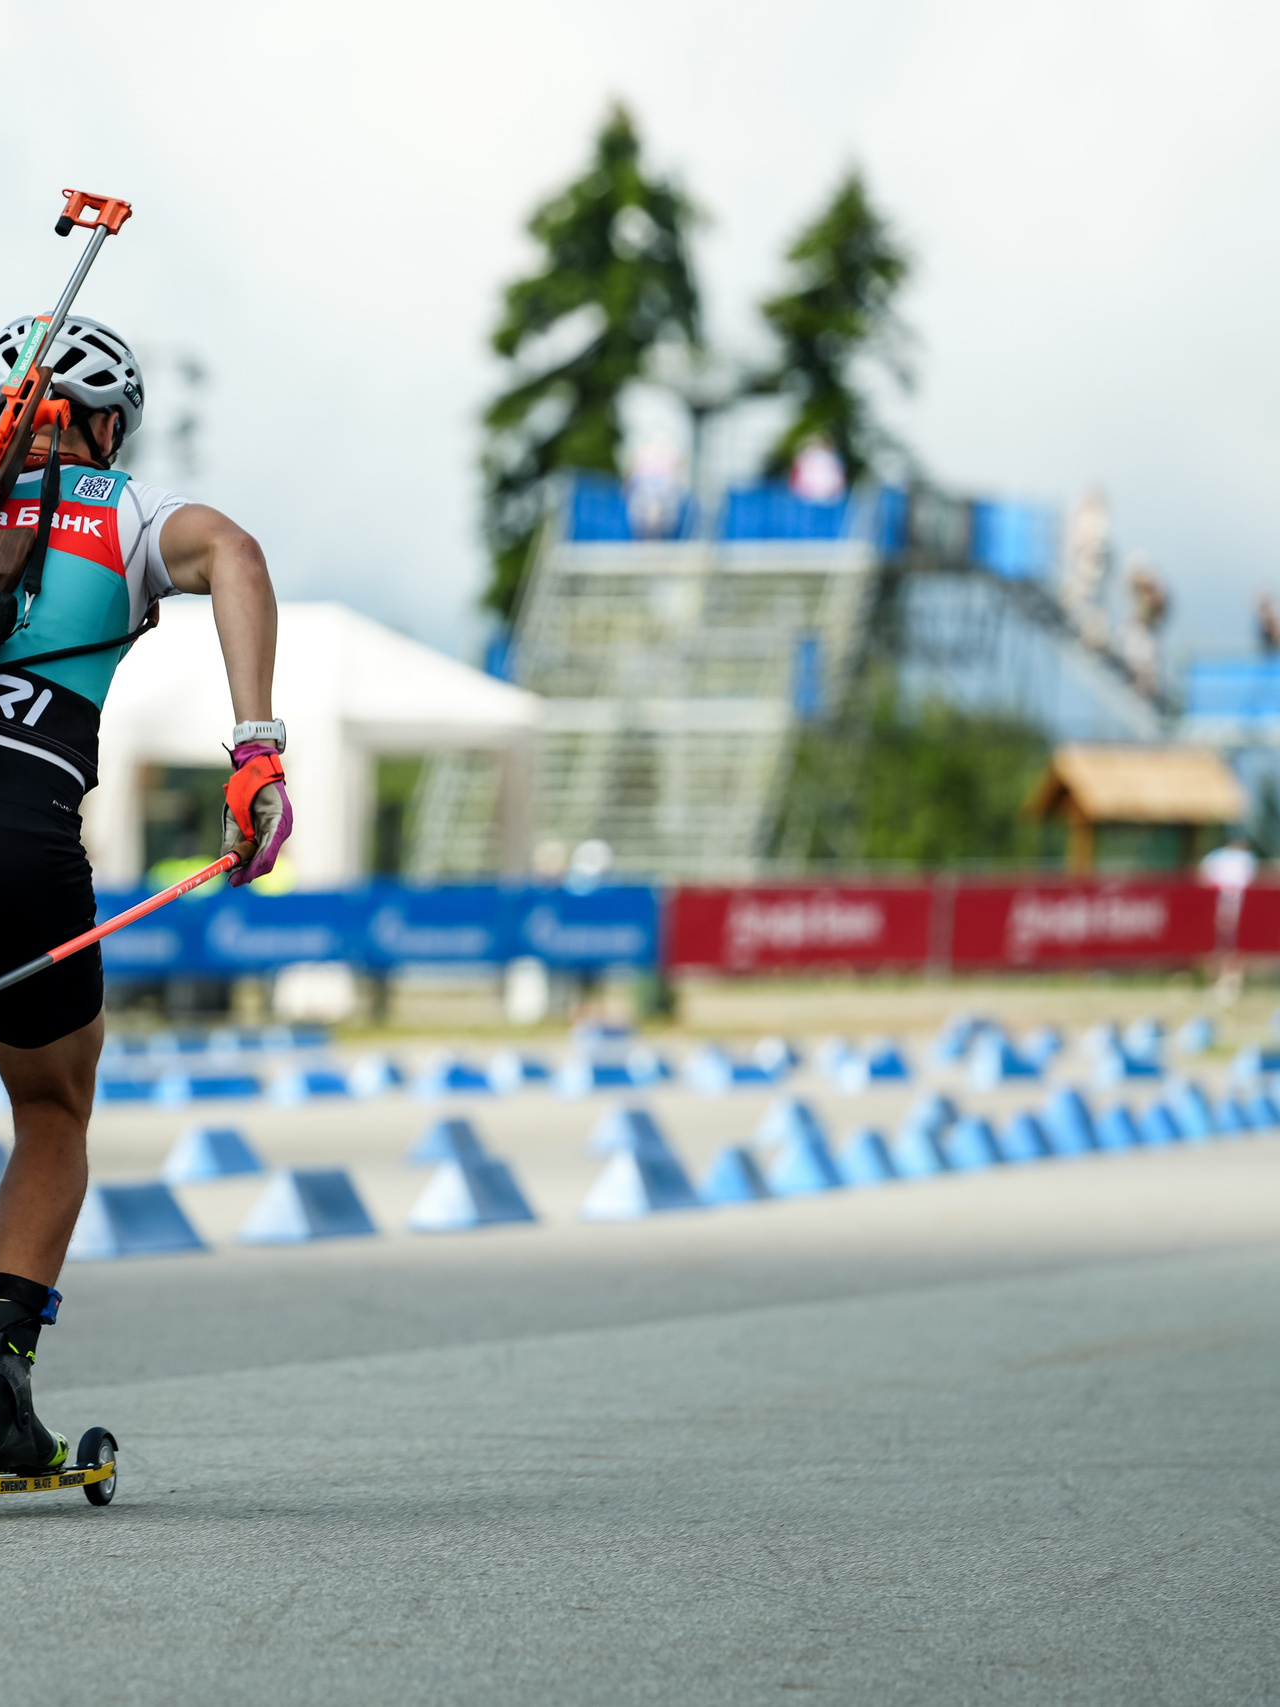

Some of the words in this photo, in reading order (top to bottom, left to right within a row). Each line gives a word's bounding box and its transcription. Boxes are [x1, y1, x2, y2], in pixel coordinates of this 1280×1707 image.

[19, 321, 47, 371] BELORUSNEFT
[78, 487, 106, 499] 2024
[0, 1480, 28, 1492] SWENOR
[33, 1477, 51, 1489] SKATE
[58, 1472, 86, 1487] SWENOR
